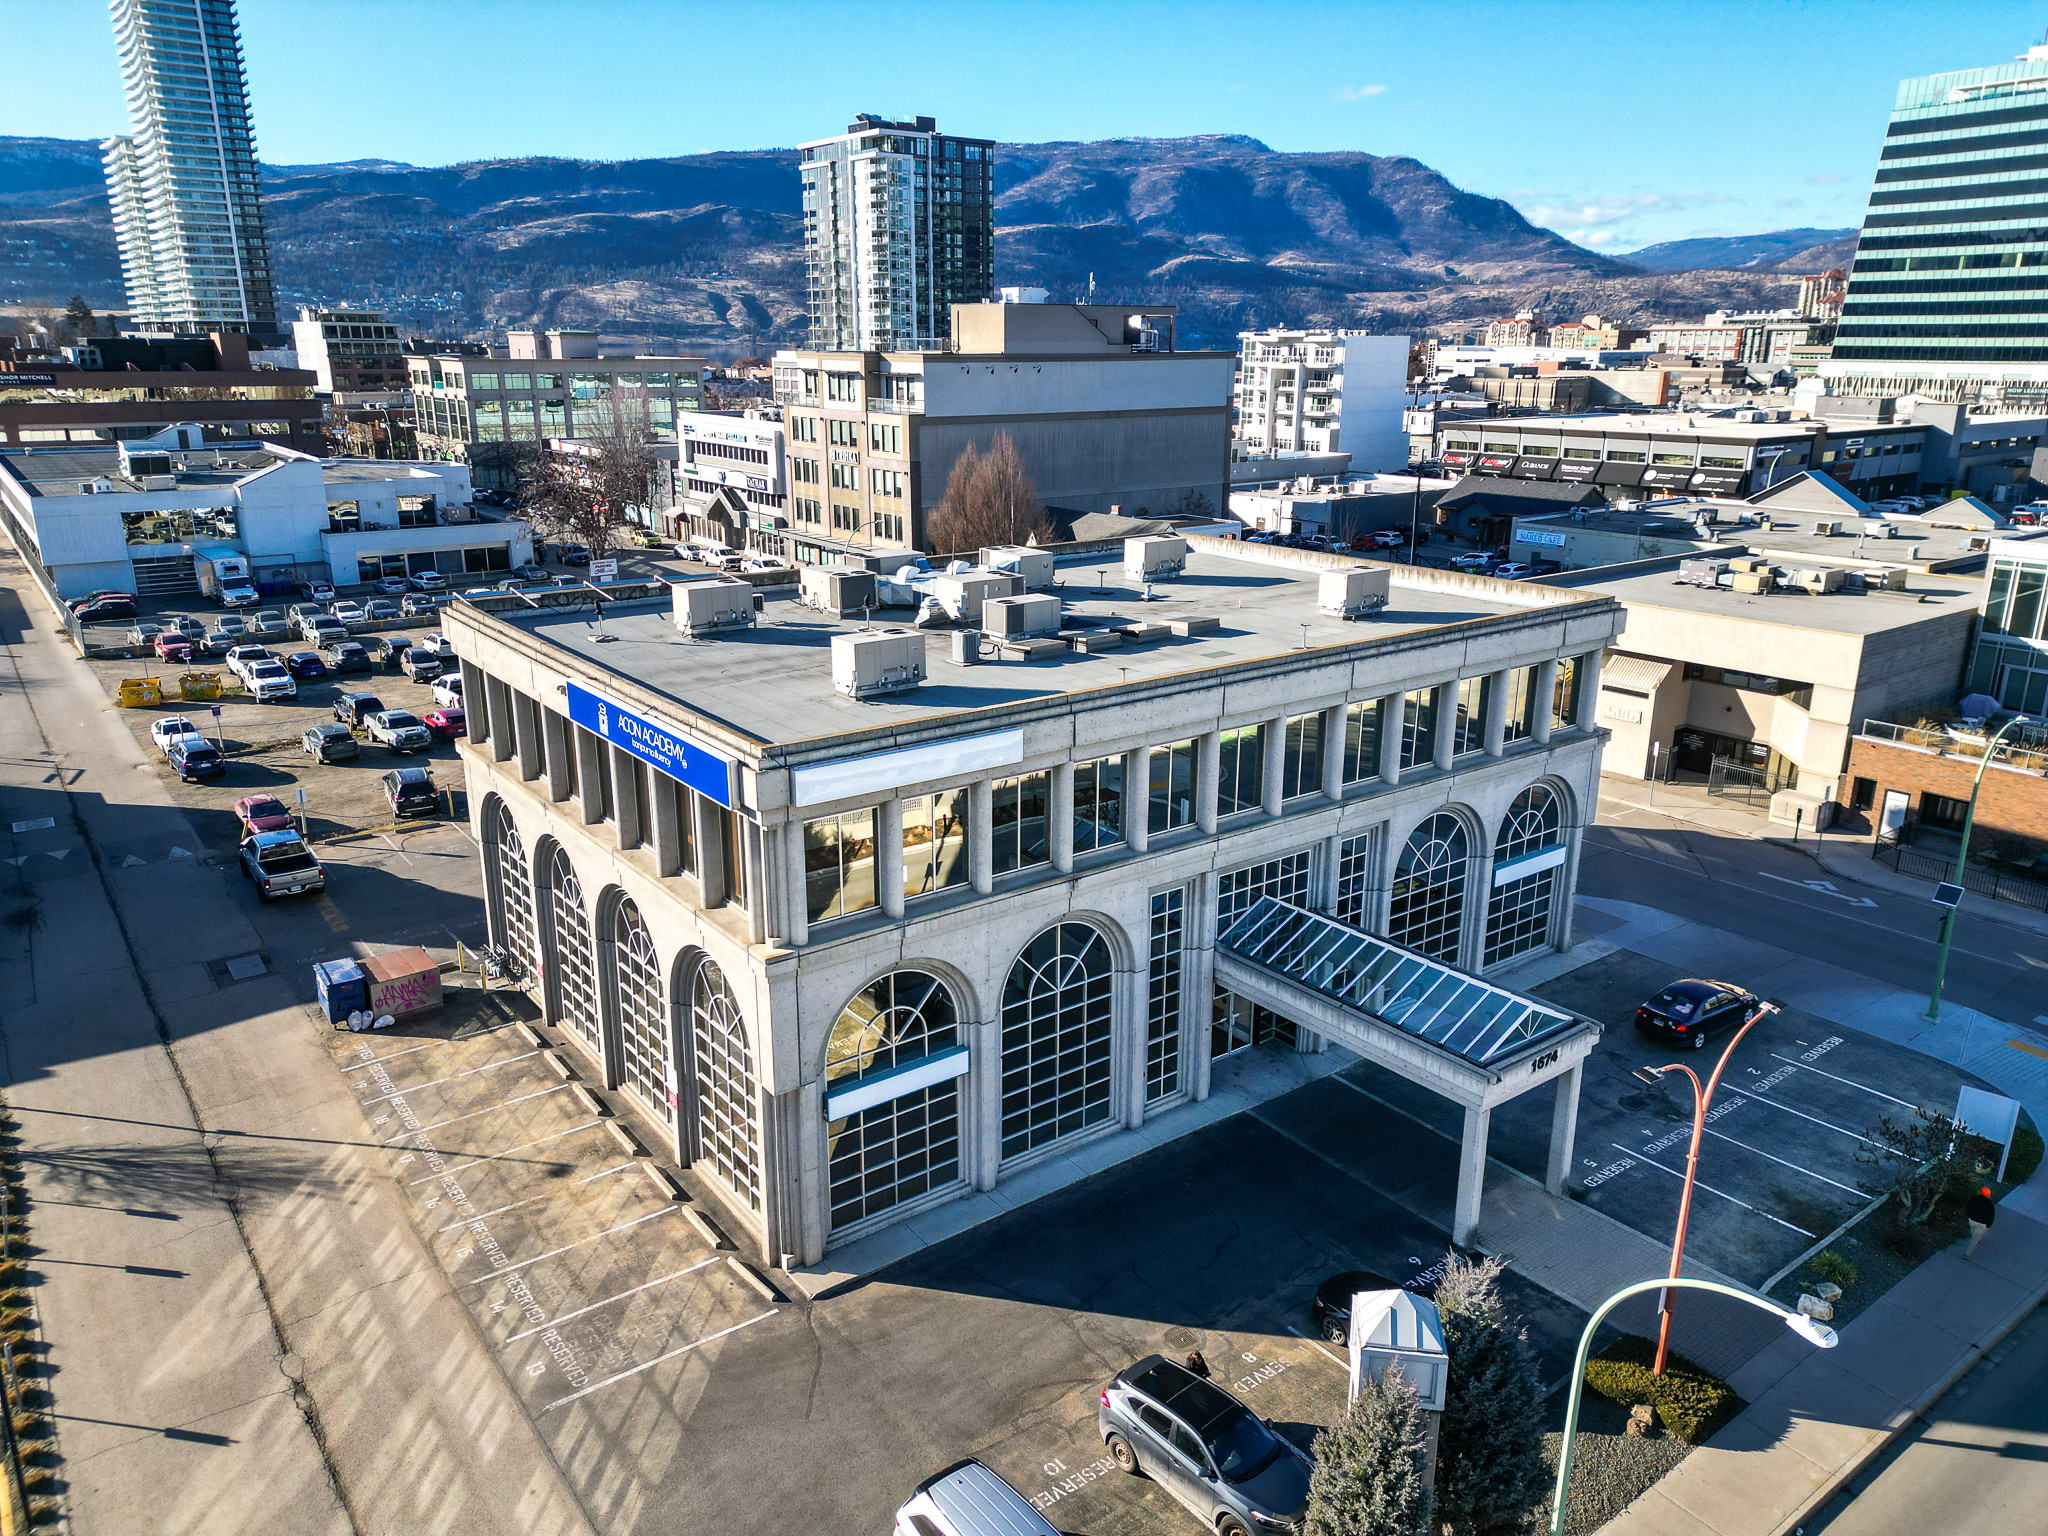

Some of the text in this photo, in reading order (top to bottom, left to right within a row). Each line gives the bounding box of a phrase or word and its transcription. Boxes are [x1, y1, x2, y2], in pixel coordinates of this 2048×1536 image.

[1520, 532, 1543, 542] NAKED
[642, 727, 685, 762] ACADEMY
[1801, 1036, 1844, 1062] RESERVED
[1531, 1049, 1559, 1073] 1674
[1747, 1067, 1761, 1075] 2
[353, 1080, 368, 1089] 19
[368, 1062, 397, 1094] RESERVED
[1752, 1065, 1798, 1092] RESERVED
[373, 1114, 390, 1125] 18
[389, 1096, 420, 1130] RESERVED
[1704, 1096, 1748, 1123] RESERVED
[1641, 1129, 1653, 1137] 4
[1642, 1126, 1693, 1155] RESERVED
[399, 1153, 416, 1163] 17
[413, 1133, 447, 1172] RESERVED
[1583, 1159, 1598, 1168] 5
[1583, 1157, 1637, 1187] RESERVED
[425, 1196, 442, 1209] 16
[455, 1246, 475, 1258] 15
[469, 1220, 510, 1268] RESERVED
[488, 1299, 509, 1313] 14
[503, 1272, 547, 1323] RESERVED
[540, 1328, 589, 1388] RESERVED
[1241, 1351, 1257, 1363] 8
[526, 1361, 547, 1377] 13
[1043, 1458, 1067, 1476] 10
